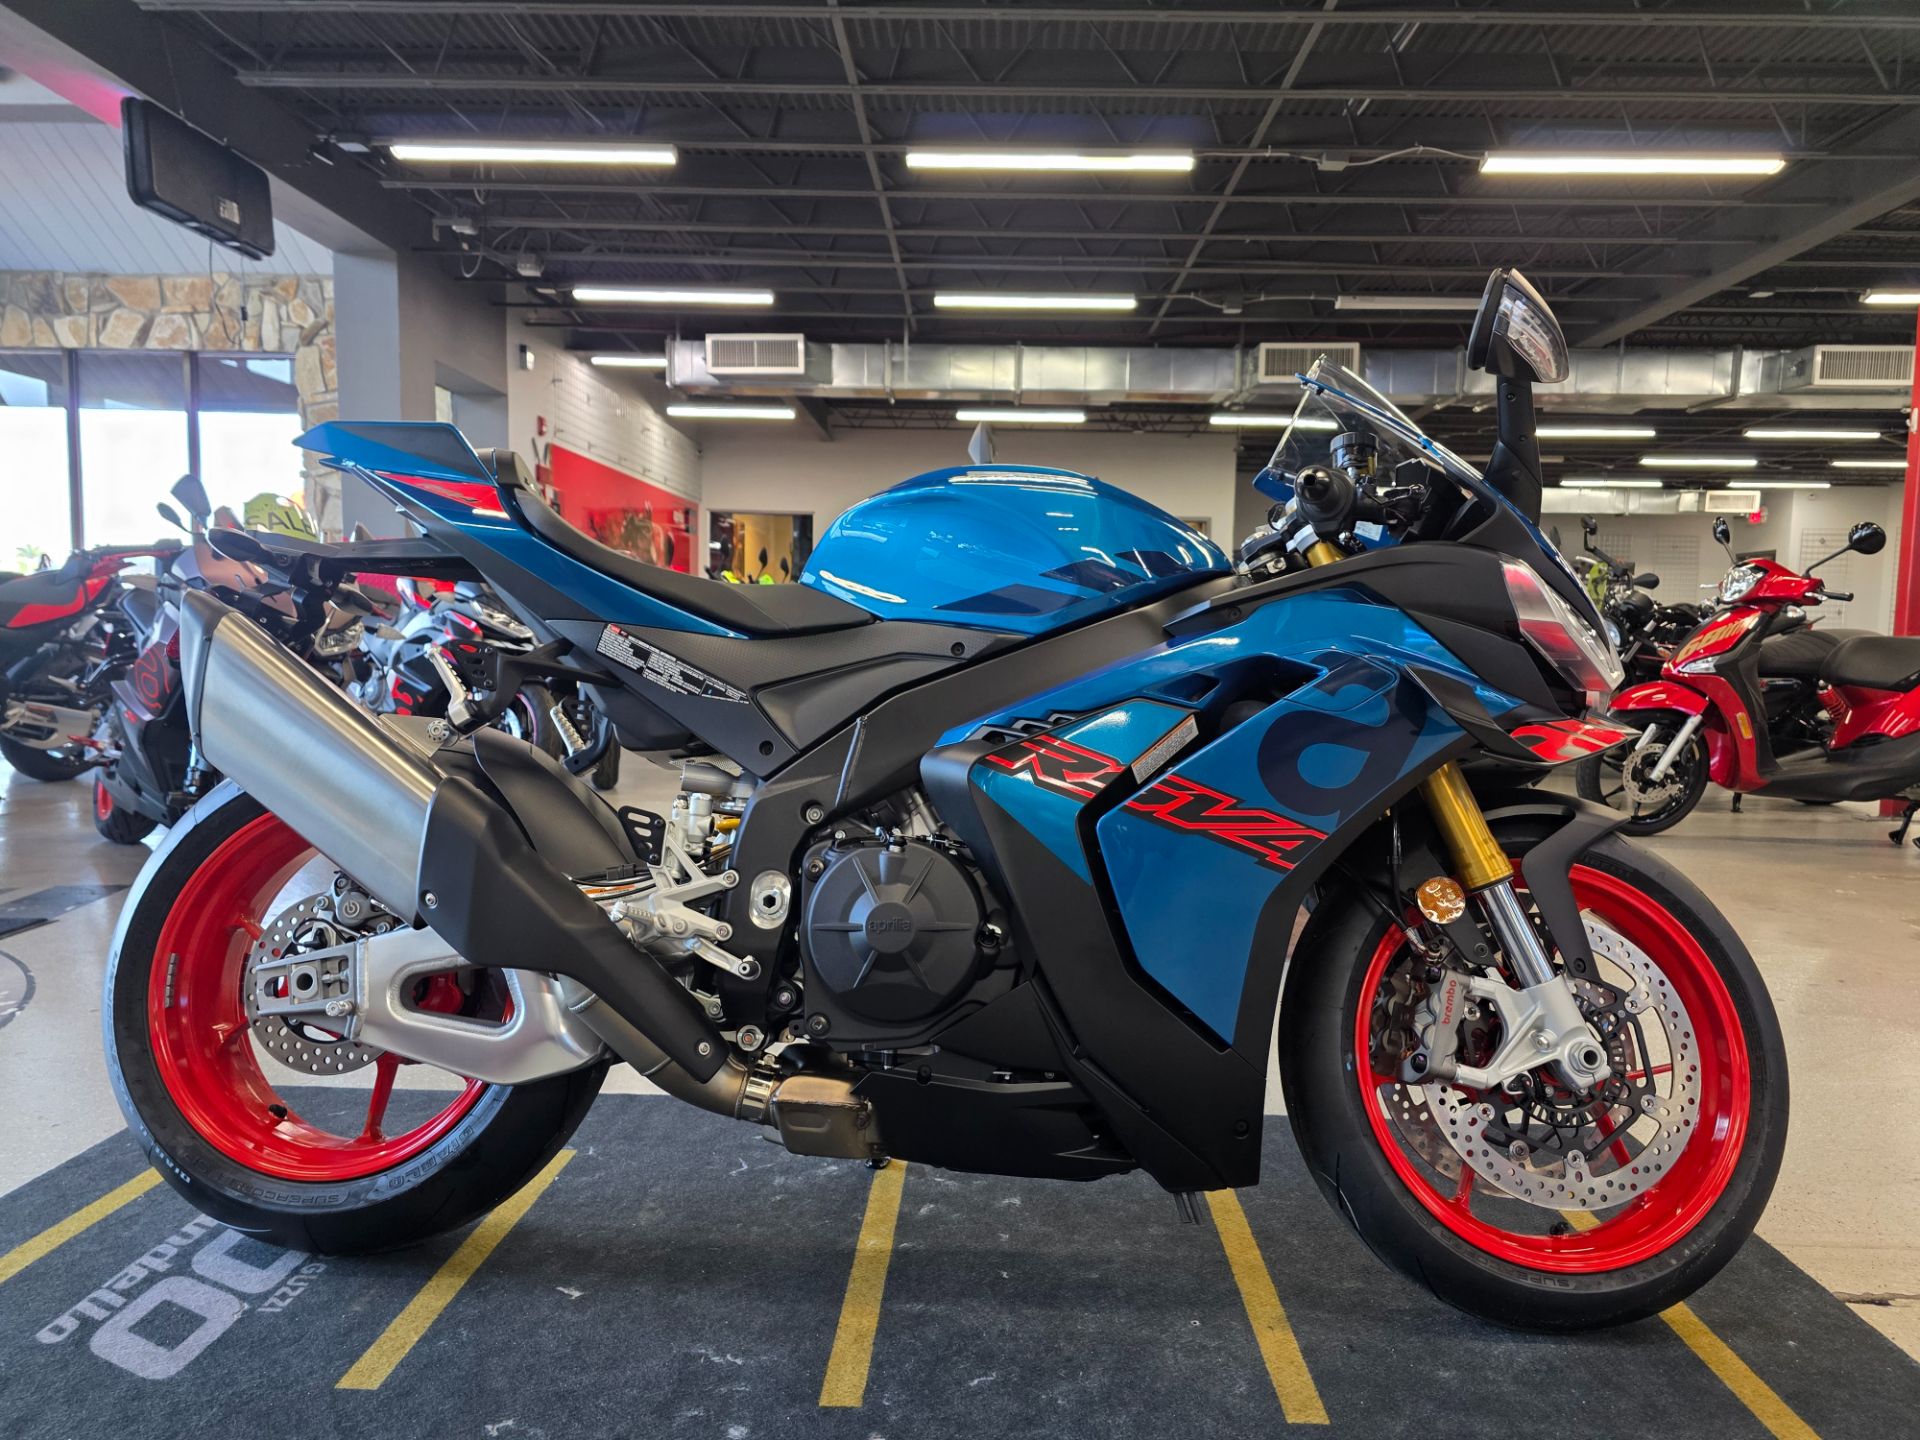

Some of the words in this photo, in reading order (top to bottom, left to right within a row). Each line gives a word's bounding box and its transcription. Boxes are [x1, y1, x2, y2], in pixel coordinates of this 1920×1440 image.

[868, 915, 911, 936] aprilia
[1441, 979, 1458, 1026] brembo
[256, 1262, 328, 1313] GUZZI
